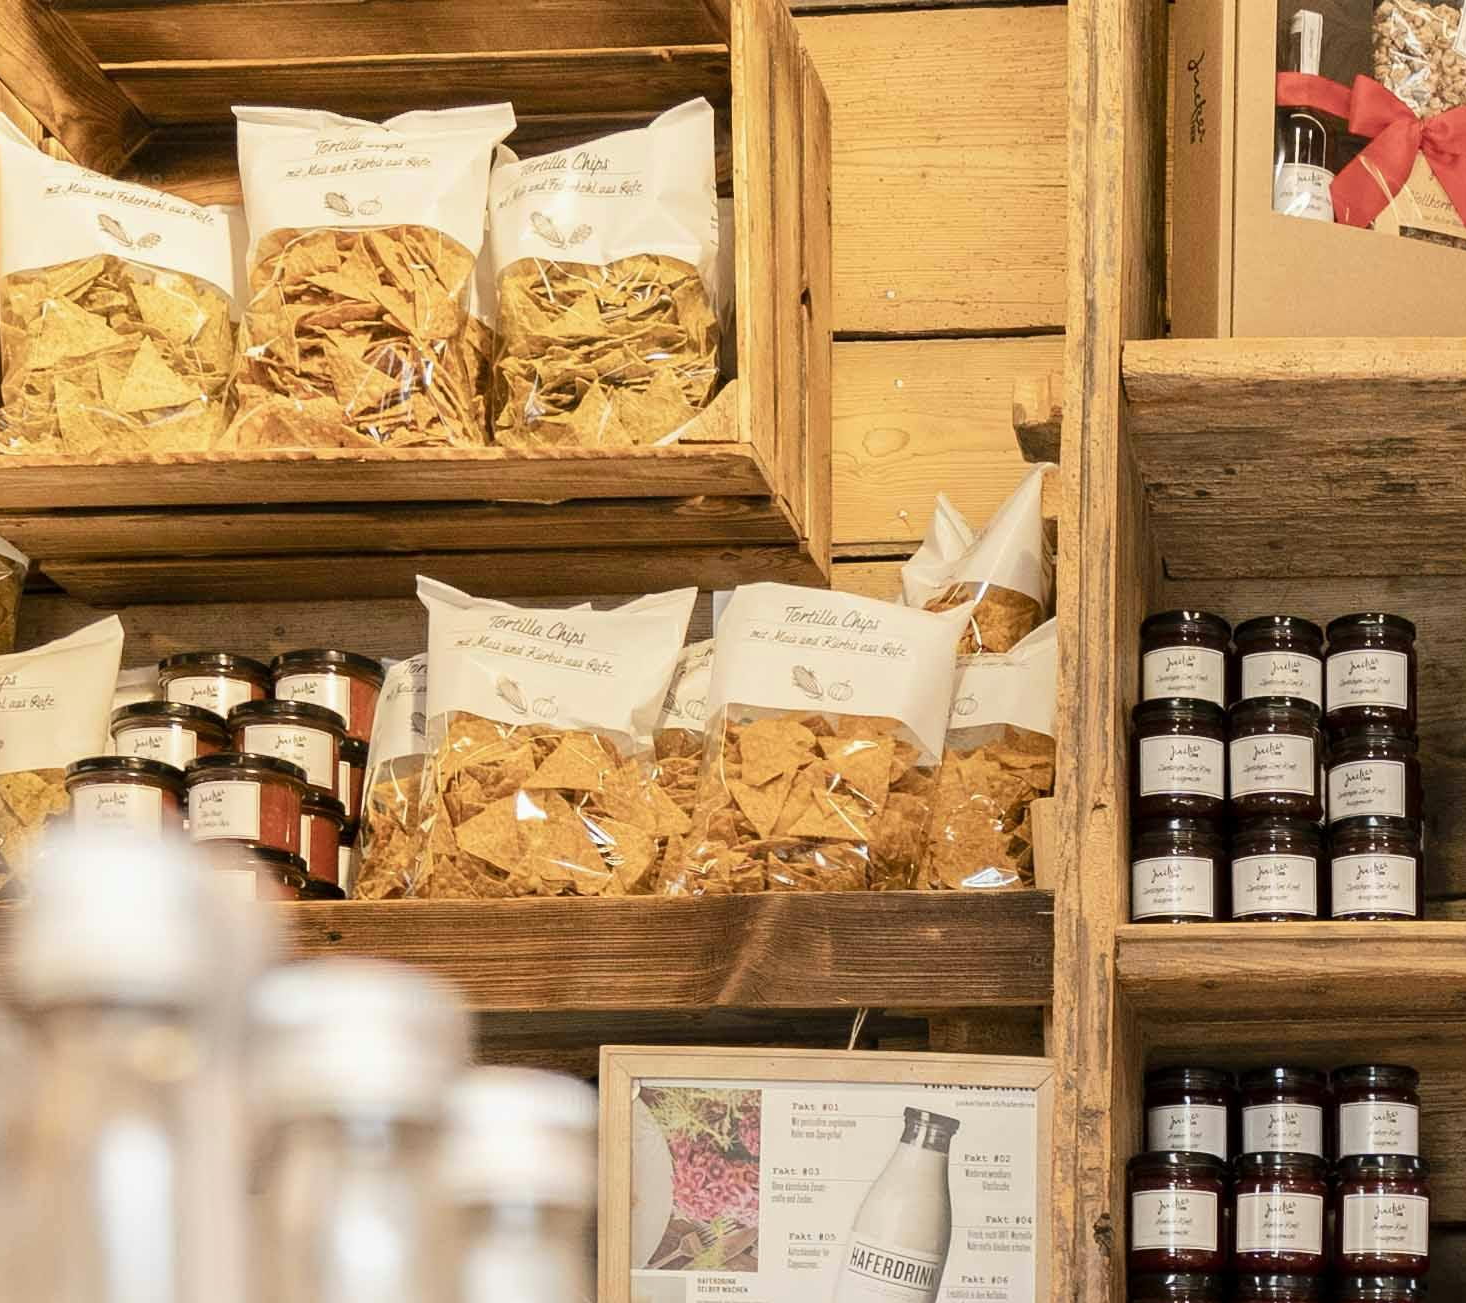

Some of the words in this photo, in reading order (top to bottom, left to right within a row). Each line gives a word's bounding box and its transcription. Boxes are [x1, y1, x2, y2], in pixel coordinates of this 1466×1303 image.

[315, 138, 363, 156] Tortilla
[572, 152, 610, 176] Chips
[489, 615, 543, 639] Tortilla
[546, 621, 587, 648] Chips
[784, 606, 836, 628] Tortilla
[841, 610, 882, 633] Chips
[473, 636, 501, 650] Mais
[504, 642, 524, 654] und
[526, 645, 562, 665] Kürbis
[564, 657, 584, 668] aus
[772, 629, 797, 643] Mais
[800, 633, 819, 646] und
[821, 635, 857, 651] Kürbis
[859, 641, 878, 653] aus
[964, 1153, 988, 1162] Fakt
[850, 1247, 935, 1288] HAFERDRINK
